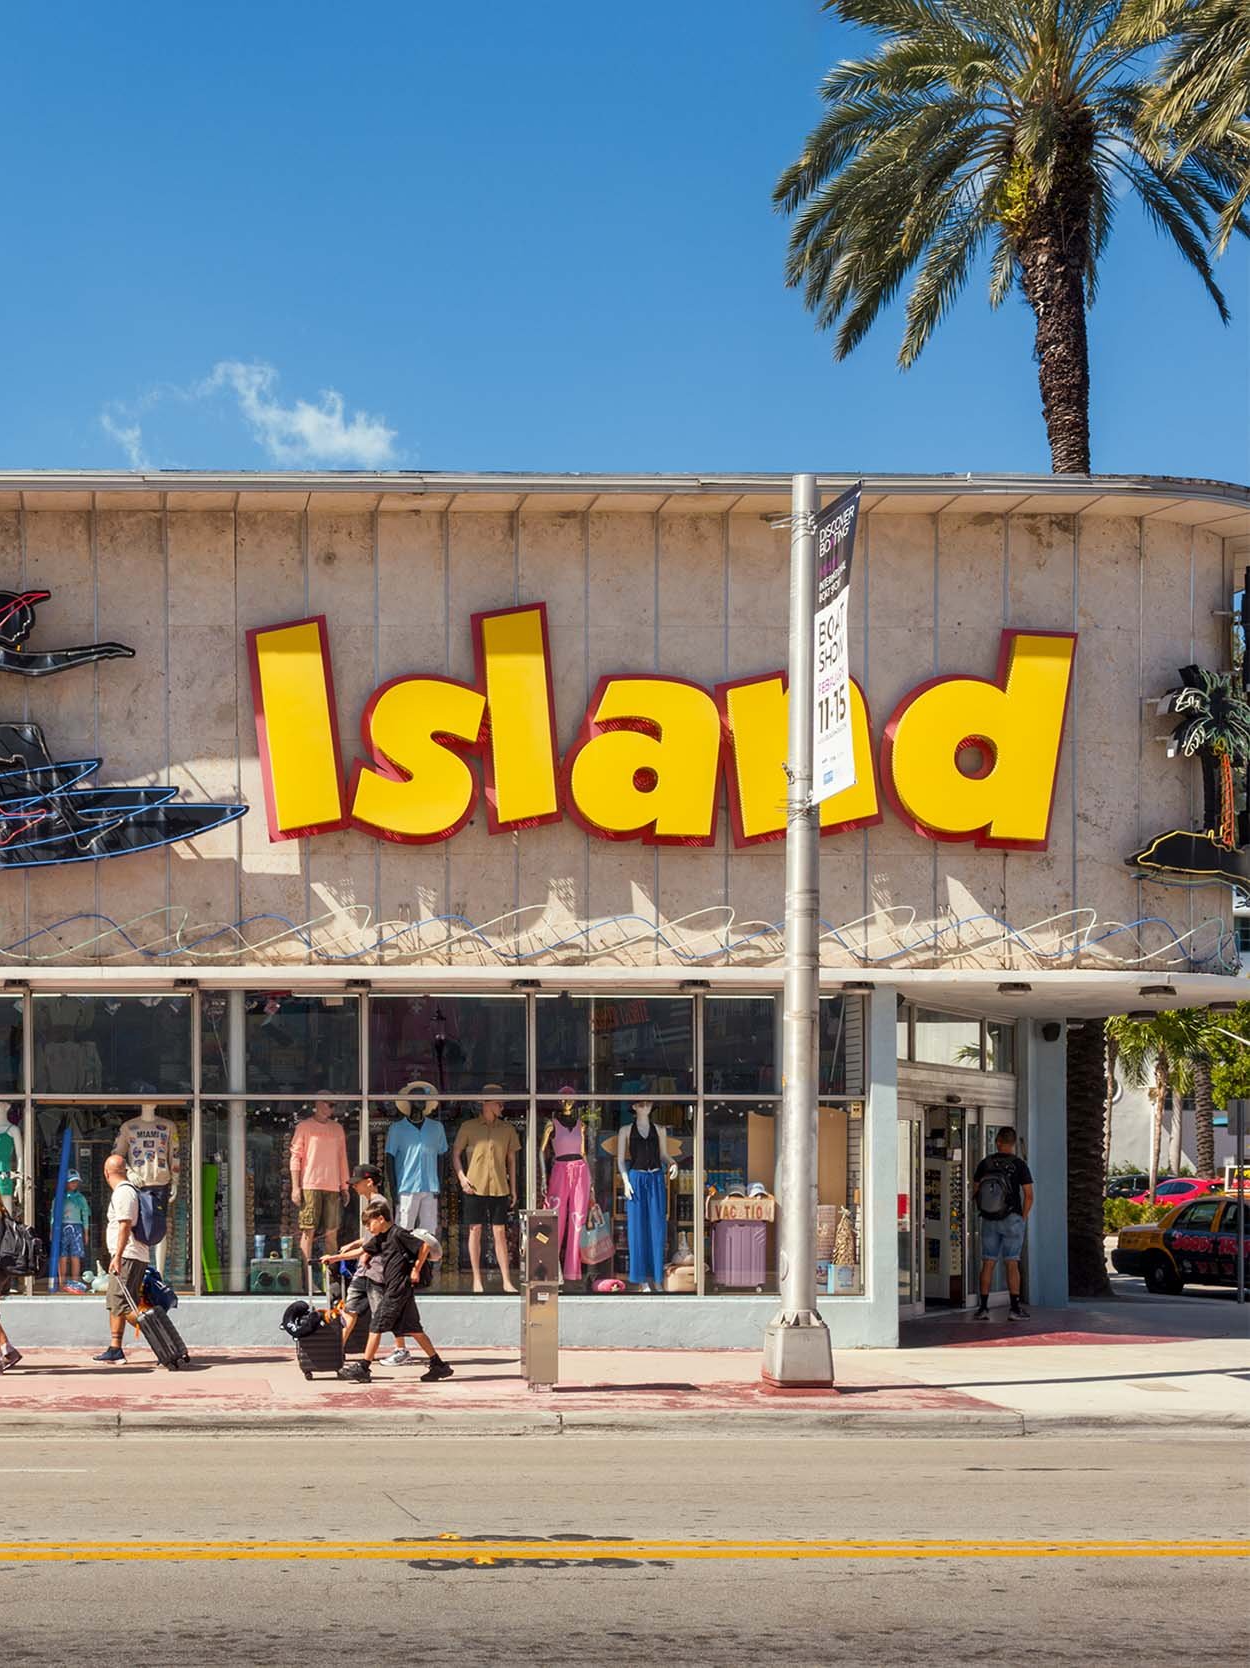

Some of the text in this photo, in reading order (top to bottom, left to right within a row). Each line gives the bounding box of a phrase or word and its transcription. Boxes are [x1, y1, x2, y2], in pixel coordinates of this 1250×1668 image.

[819, 505, 855, 543] DISCOVER
[818, 601, 845, 647] BOAT
[818, 634, 845, 673] SHOW
[246, 602, 1078, 852] Island
[137, 1130, 160, 1138] MIAMI
[715, 1204, 773, 1220] VACTION
